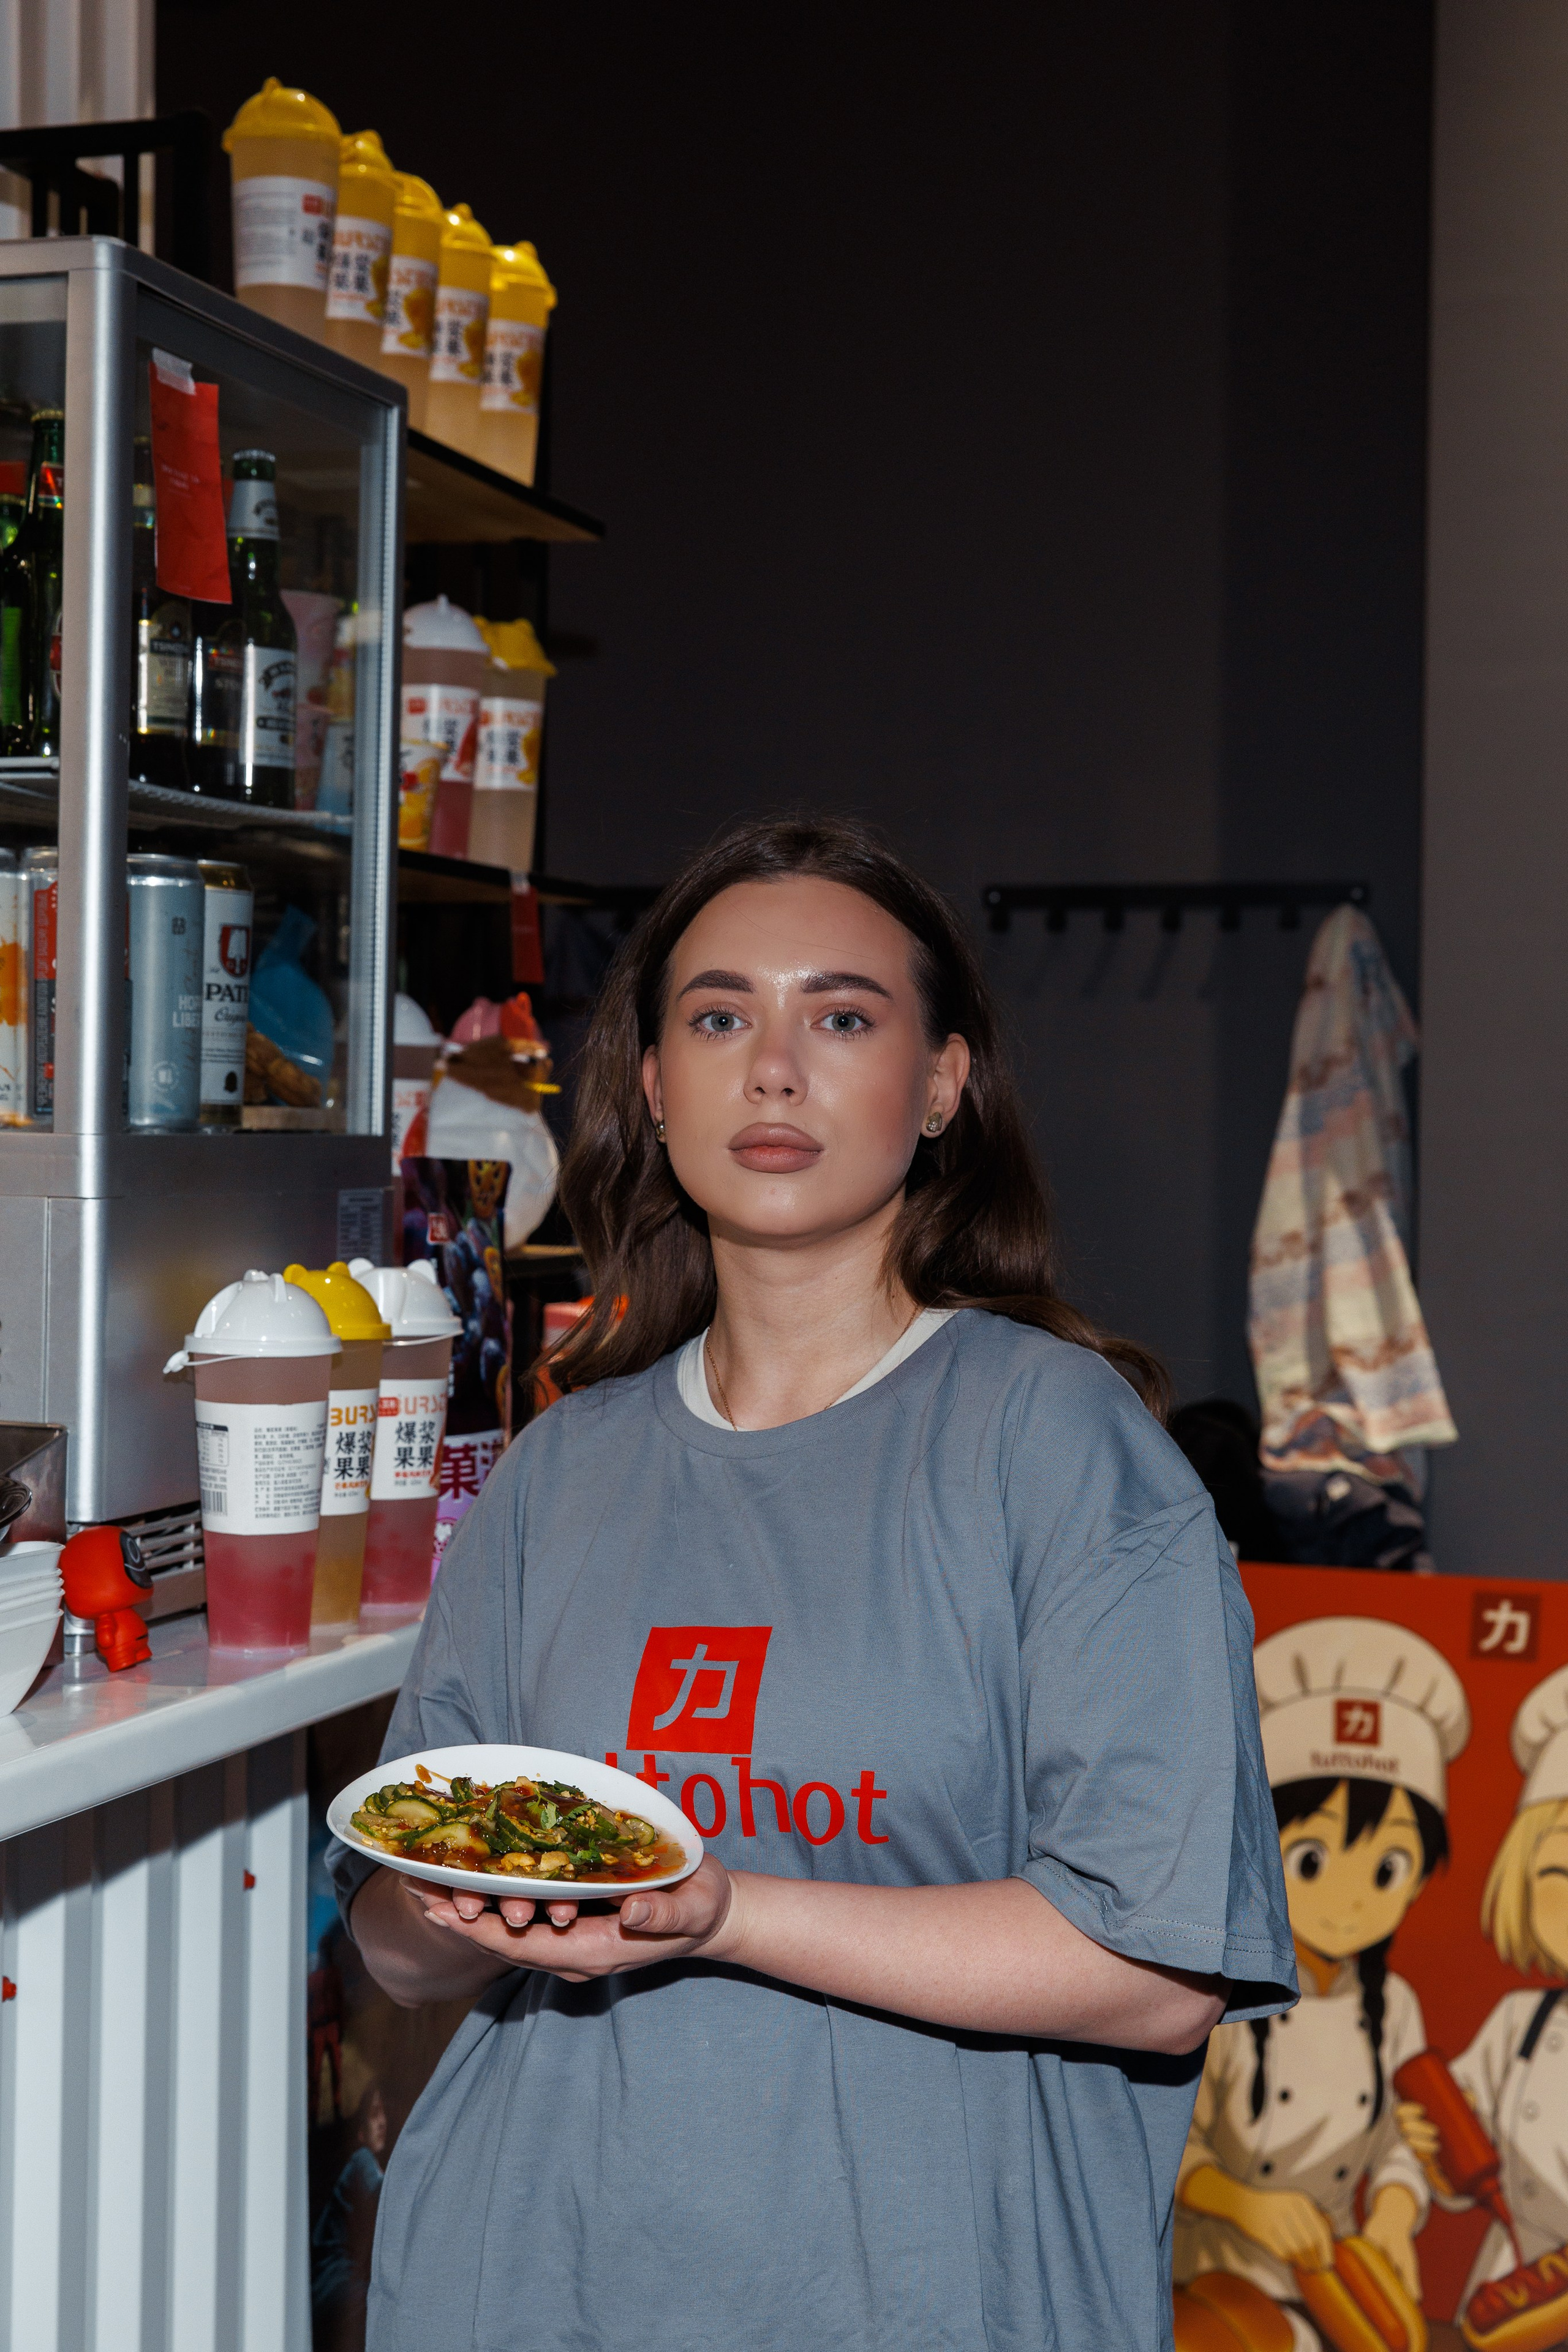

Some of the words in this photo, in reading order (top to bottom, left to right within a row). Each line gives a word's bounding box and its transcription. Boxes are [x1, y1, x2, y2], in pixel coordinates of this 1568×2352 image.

[205, 982, 248, 1003] PAT
[394, 1446, 434, 1469] 果果
[1478, 1599, 1531, 1653] 力
[653, 1643, 740, 1732] 力
[1341, 1705, 1374, 1740] 力
[605, 1752, 890, 1846] tohot
